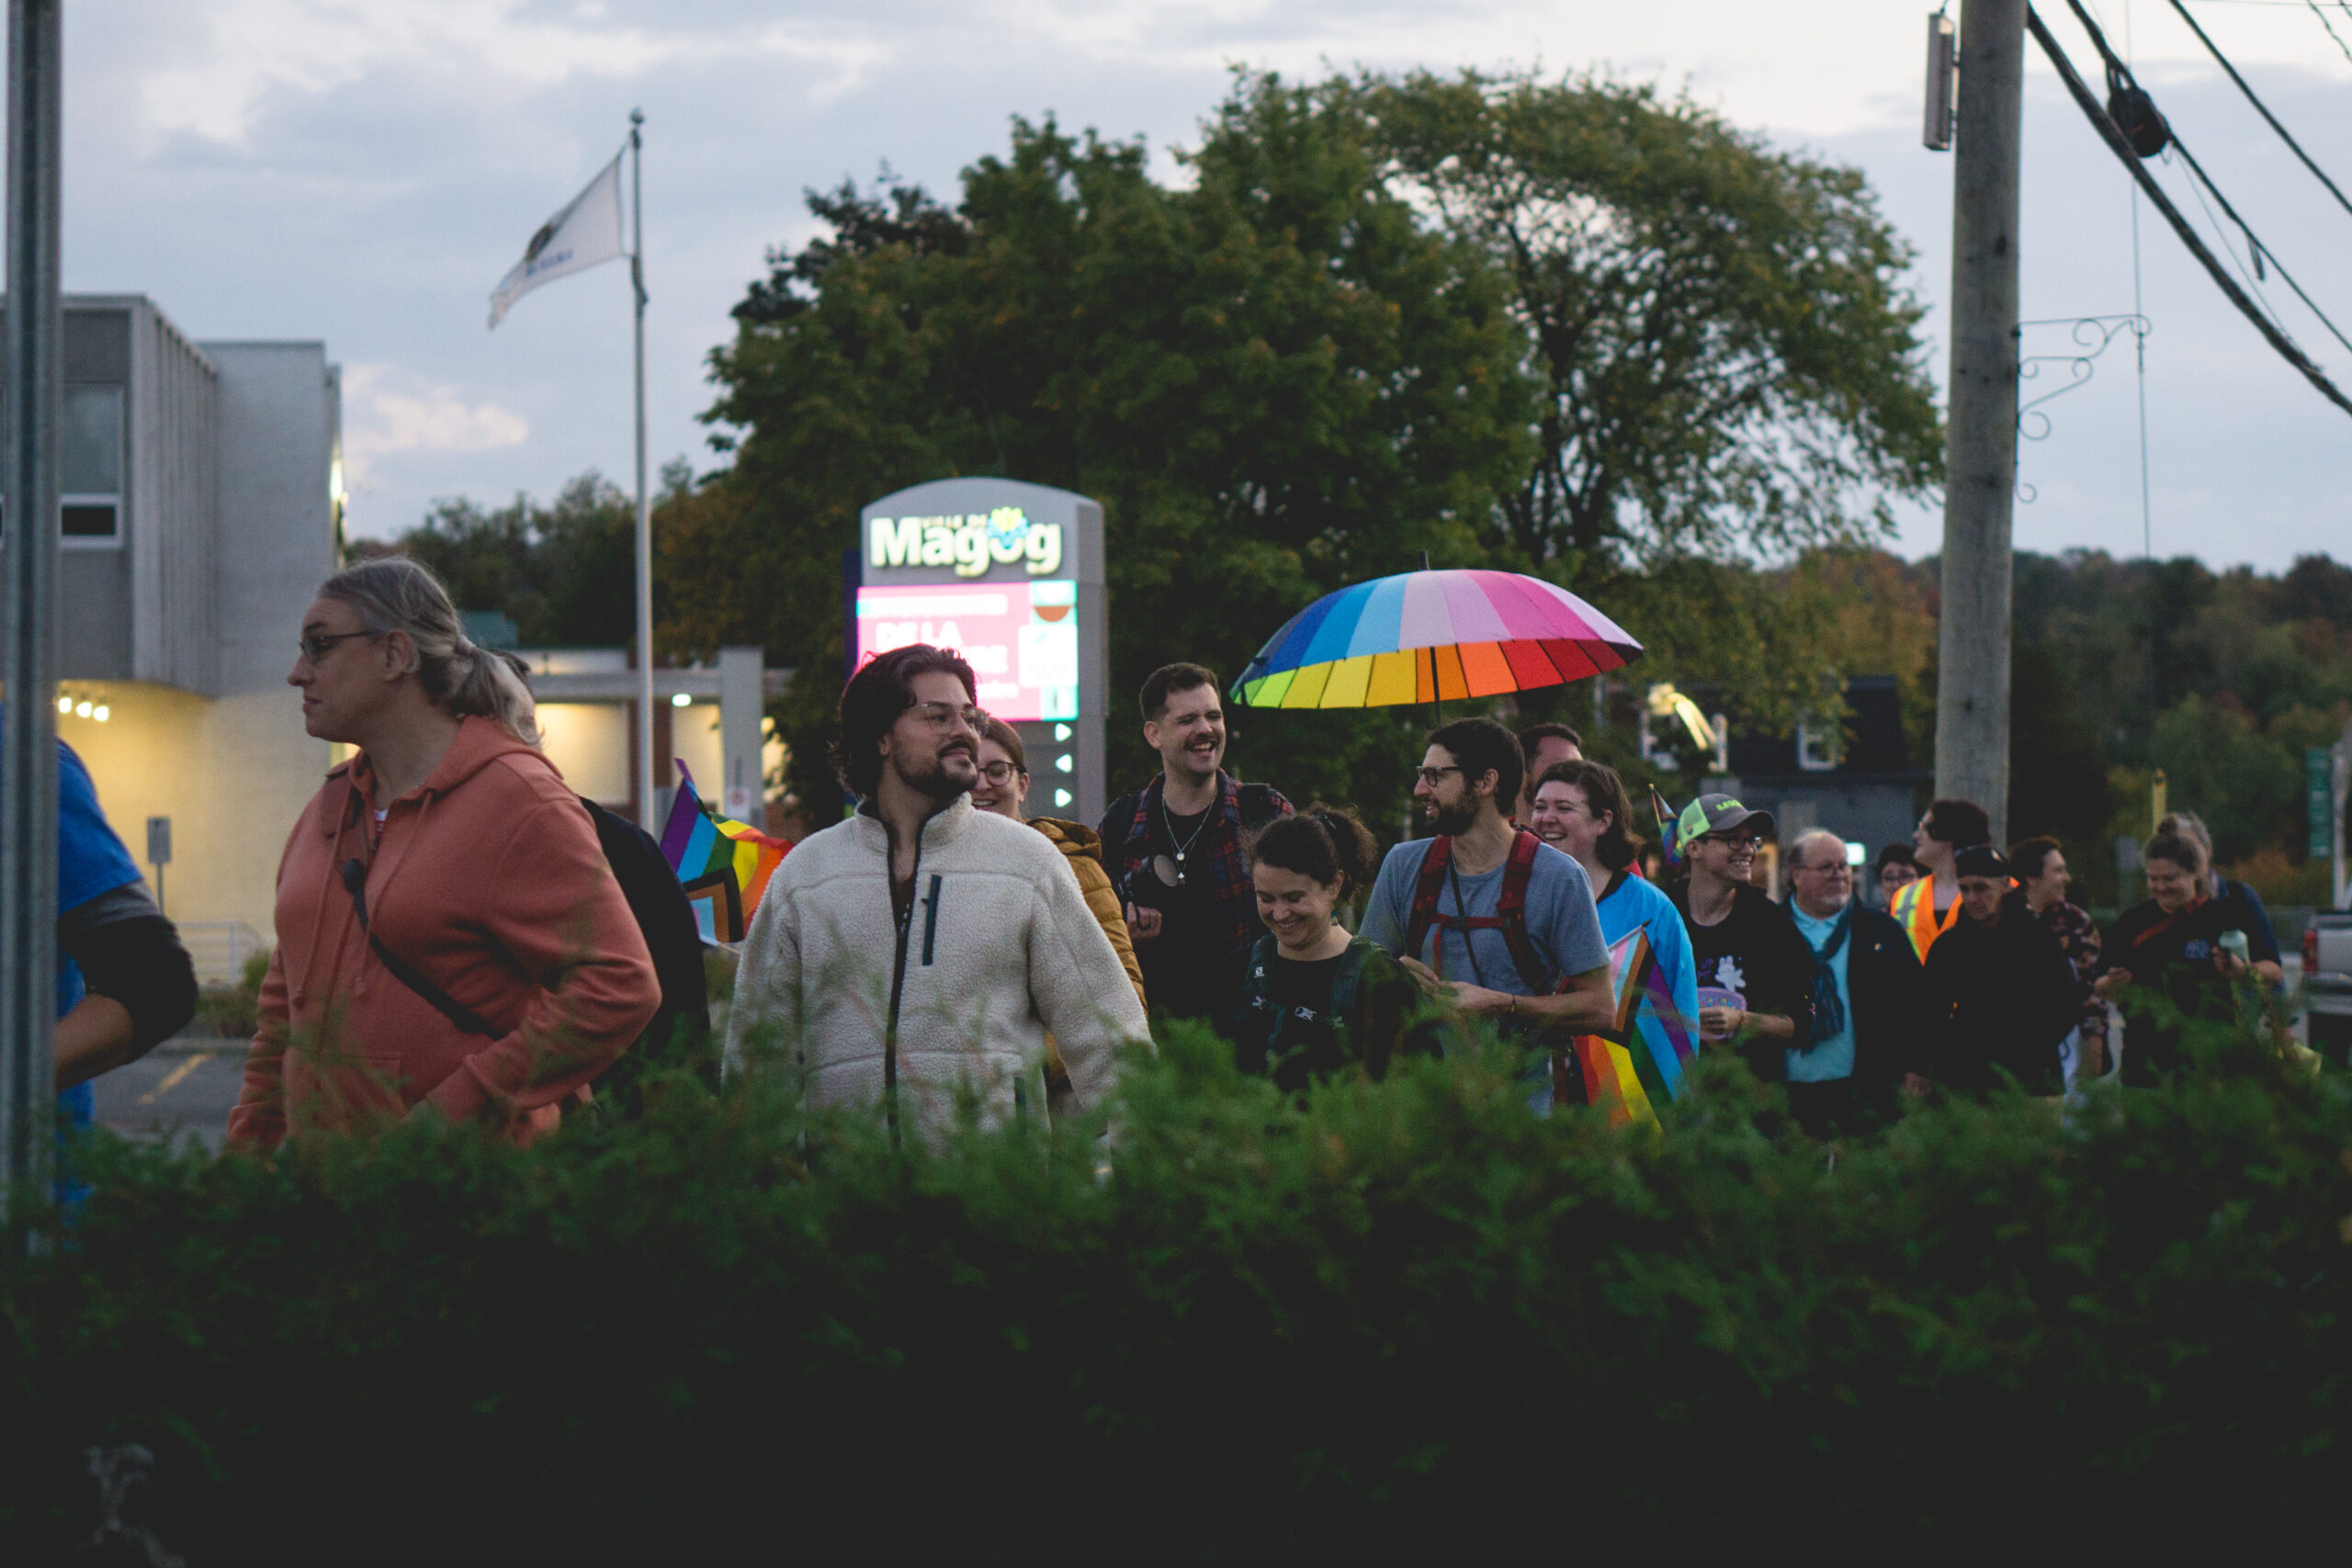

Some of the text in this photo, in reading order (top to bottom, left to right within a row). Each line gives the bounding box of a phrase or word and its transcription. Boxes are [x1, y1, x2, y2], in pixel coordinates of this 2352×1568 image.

[870, 515, 1062, 577] Magog
[875, 620, 963, 652] DE LA
